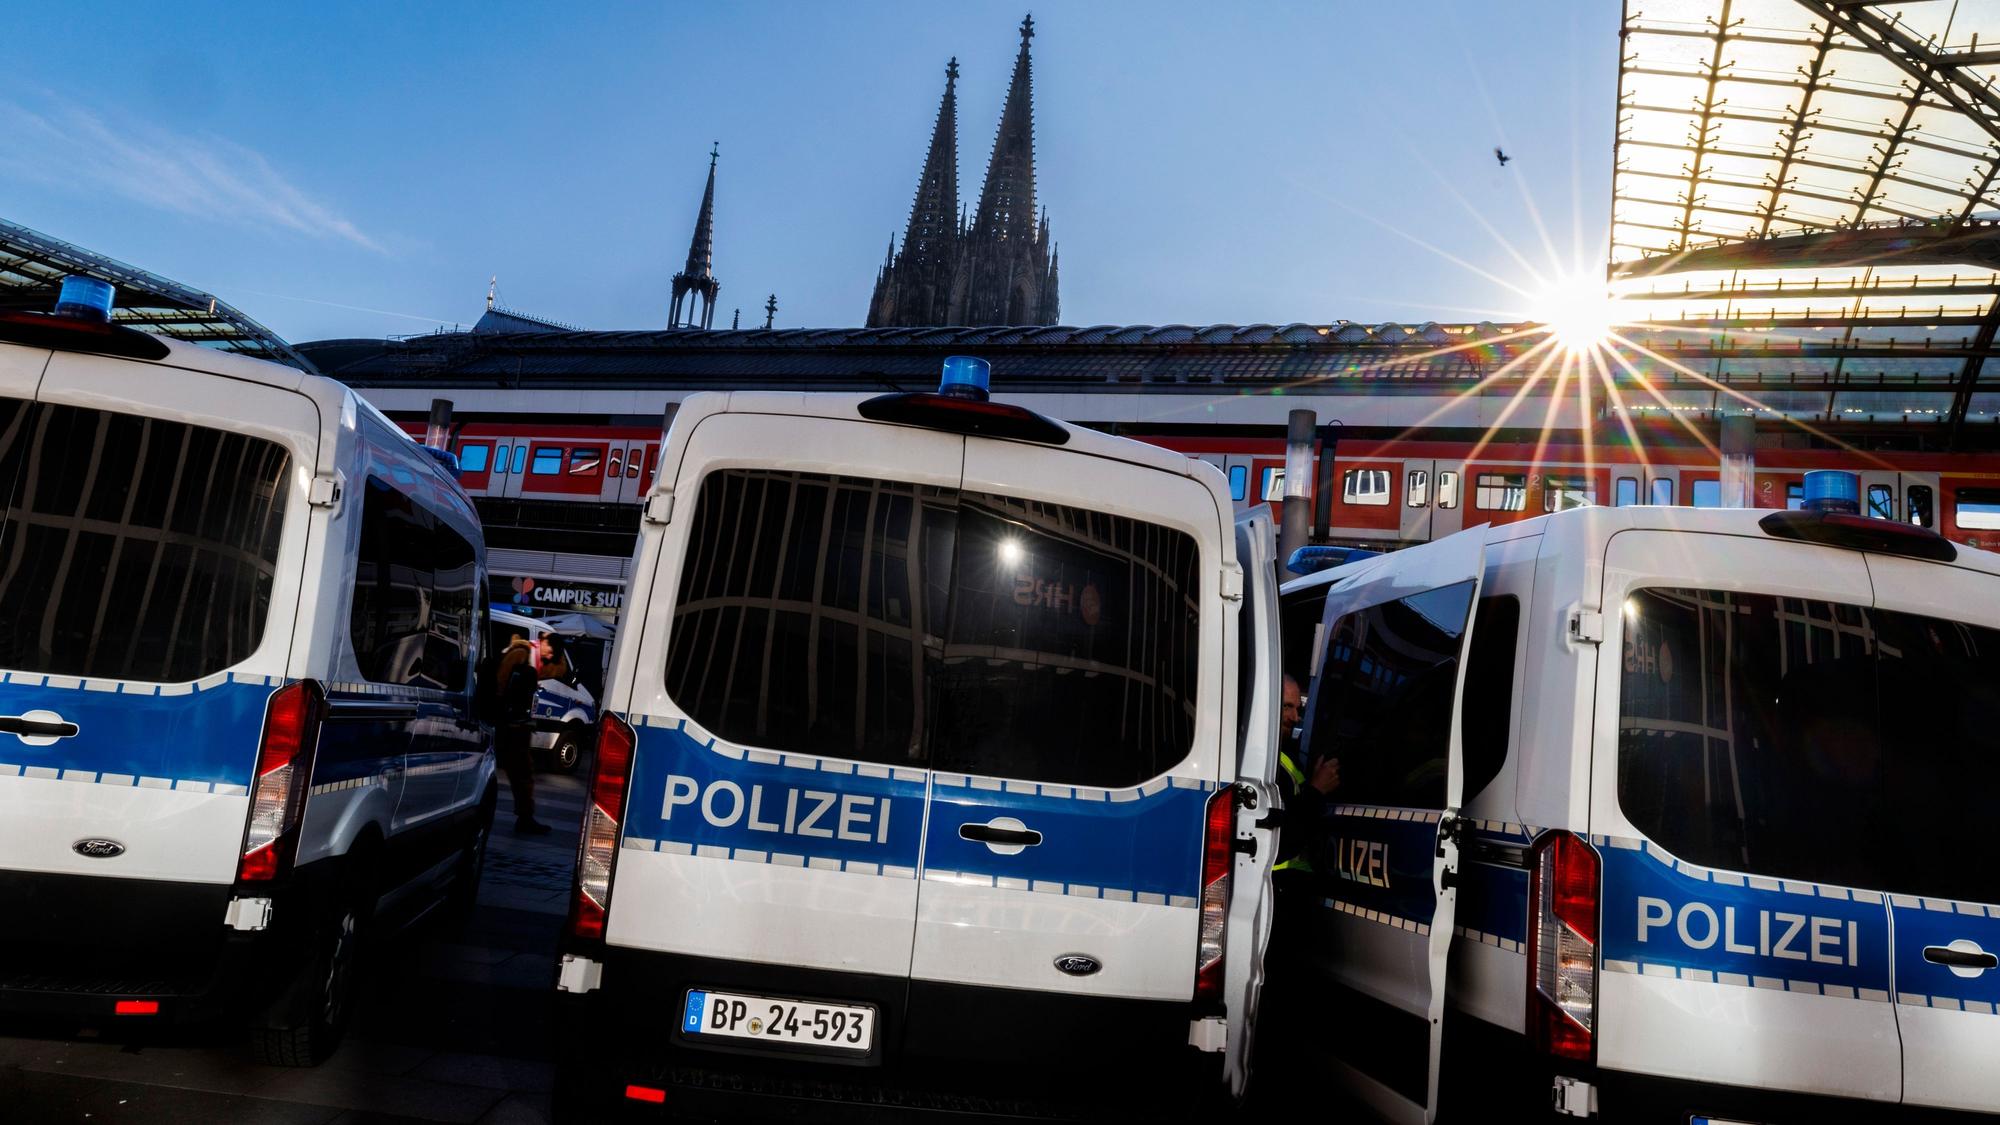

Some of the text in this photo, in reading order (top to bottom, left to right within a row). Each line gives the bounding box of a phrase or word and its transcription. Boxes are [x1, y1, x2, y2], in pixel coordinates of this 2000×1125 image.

[1763, 481, 1772, 493] 2
[534, 587, 592, 606] CAMPUS
[661, 774, 891, 844] POLIZEI
[82, 840, 114, 855] Ford
[1637, 896, 1857, 967] POLIZEI
[1065, 958, 1093, 971] Ford
[690, 1016, 698, 1025] D
[711, 998, 864, 1043] BP 24-593
